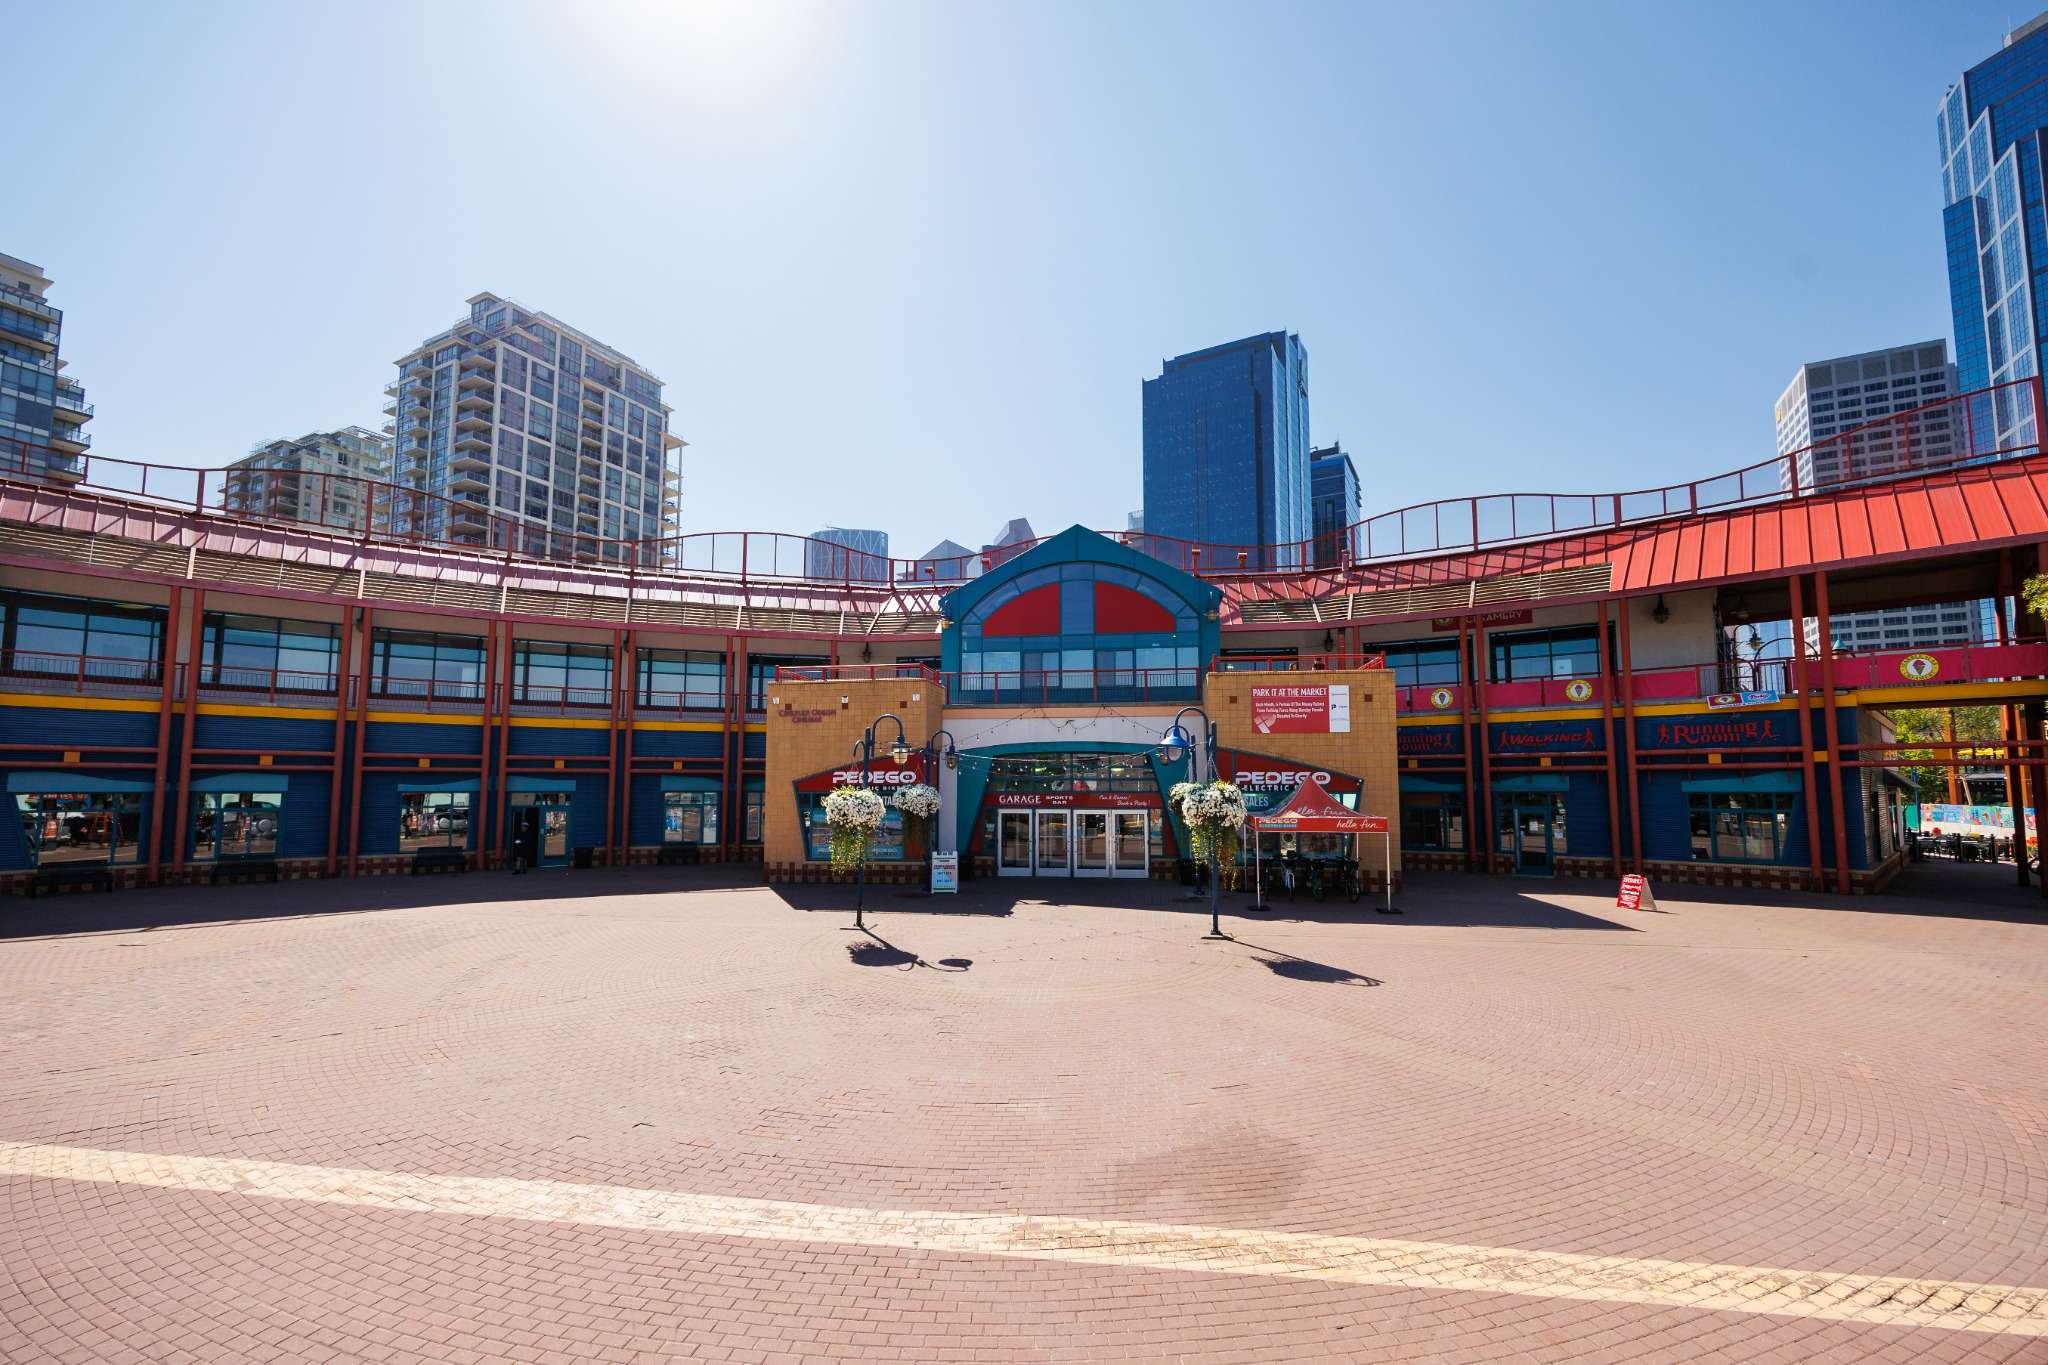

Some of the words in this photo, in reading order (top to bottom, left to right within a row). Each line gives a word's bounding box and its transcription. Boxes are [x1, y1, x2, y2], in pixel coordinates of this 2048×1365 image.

[1252, 688, 1270, 697] PARK
[1271, 688, 1278, 697] IT
[1278, 688, 1286, 697] AT
[1287, 687, 1300, 696] THE
[1300, 687, 1328, 696] MARKET
[832, 771, 917, 784] PEDEGO
[1235, 771, 1331, 785] PEDEGO
[998, 795, 1041, 804] GARAGE
[1245, 796, 1269, 807] SALES
